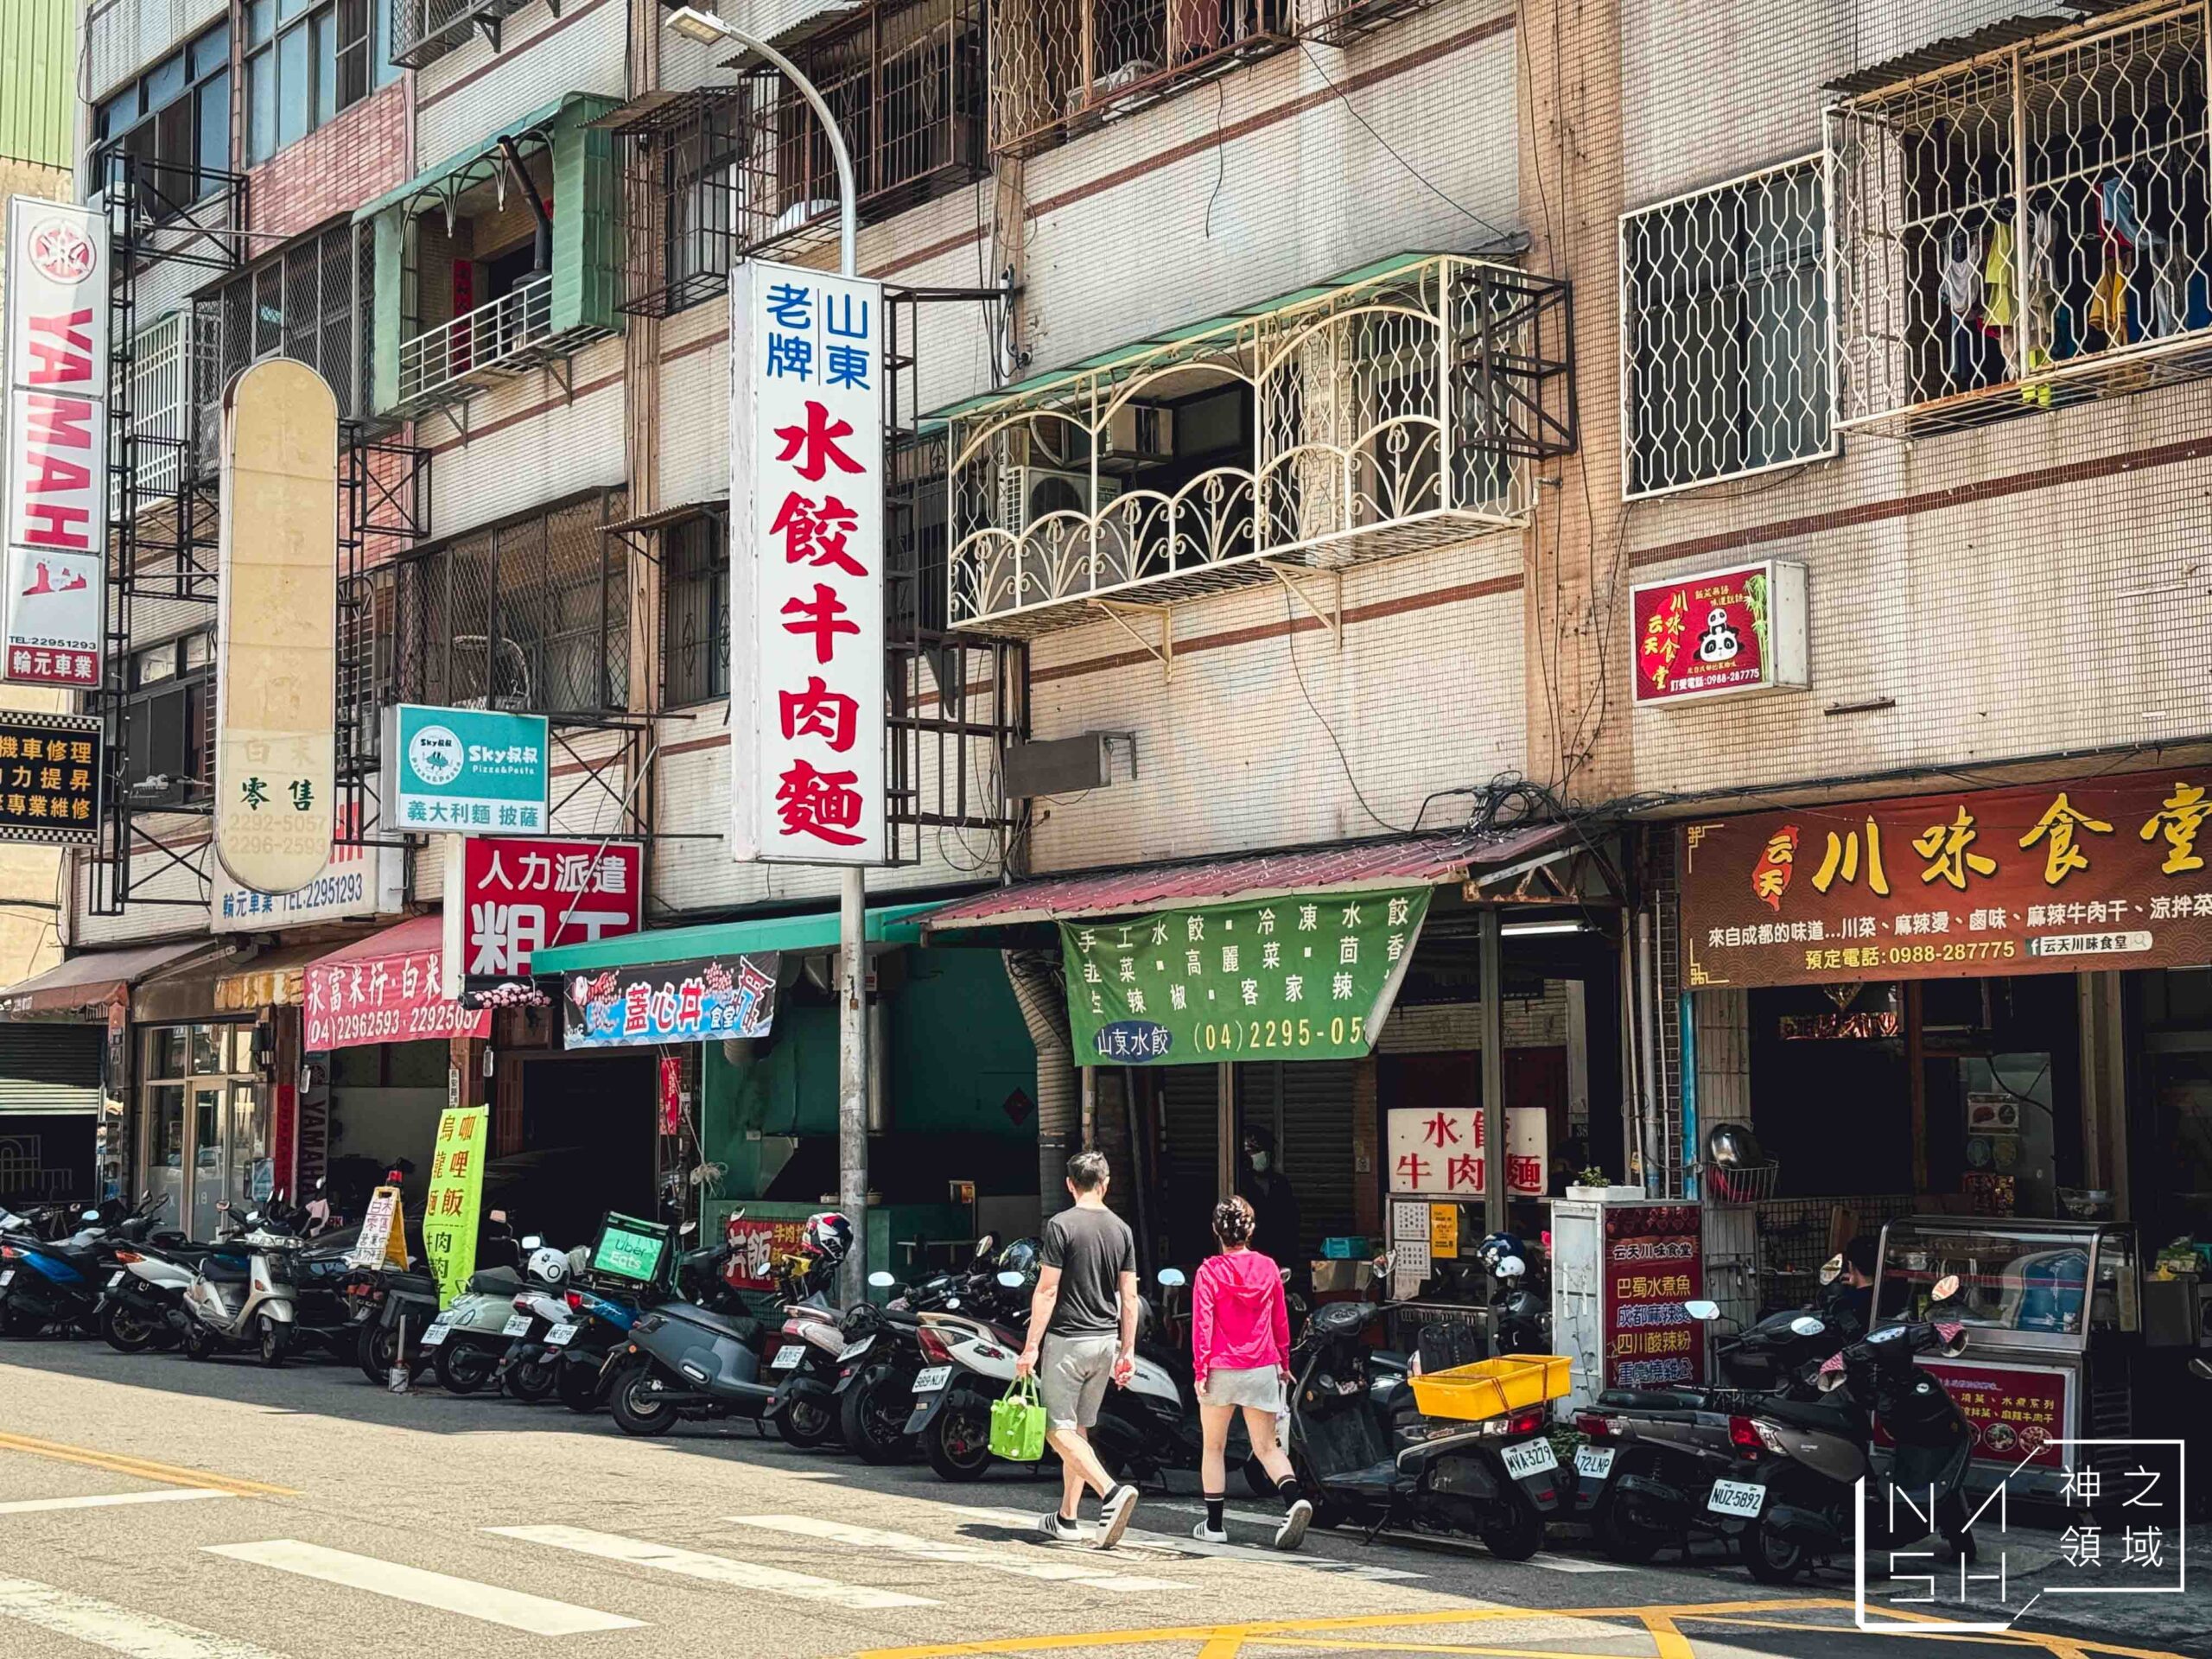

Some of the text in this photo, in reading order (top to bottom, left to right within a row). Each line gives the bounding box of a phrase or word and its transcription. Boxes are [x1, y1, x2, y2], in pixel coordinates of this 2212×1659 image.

[766, 283, 813, 382] 老牌
[825, 294, 871, 391] 山東
[769, 400, 869, 846] 水餃牛肉麵
[1643, 614, 1664, 656] 云天
[13, 650, 92, 678] 輪元車業
[0, 736, 92, 764] 機車修理
[468, 745, 538, 764] Sky叔叔
[0, 766, 92, 792] 力提昇
[0, 793, 92, 820] 專業維修
[240, 777, 315, 811] 零售
[407, 799, 539, 827] 義大利麵 披薩
[478, 849, 627, 894] 人力派遣
[1759, 834, 1794, 898] 云天
[1078, 896, 1409, 954] 手工水餃 冷凍水餃
[1185, 941, 1281, 976] 高麗菜
[2043, 935, 2128, 954] 云天川味食堂
[1097, 1015, 1366, 1056] 山東水餃 (04)2295-05
[441, 1115, 477, 1217] 咖哩飯
[1396, 1153, 1542, 1192] 牛肉麵
[609, 1250, 642, 1270] Eats
[614, 1238, 647, 1256] Uber
[1612, 1241, 1694, 1261] 云天川味食堂
[1617, 1274, 1691, 1299] 巴蜀水煮魚
[1617, 1331, 1692, 1354] 四川酸辣粉
[1506, 1445, 1552, 1473] MVA-3279
[1711, 1487, 1762, 1510] NUZ-5892
